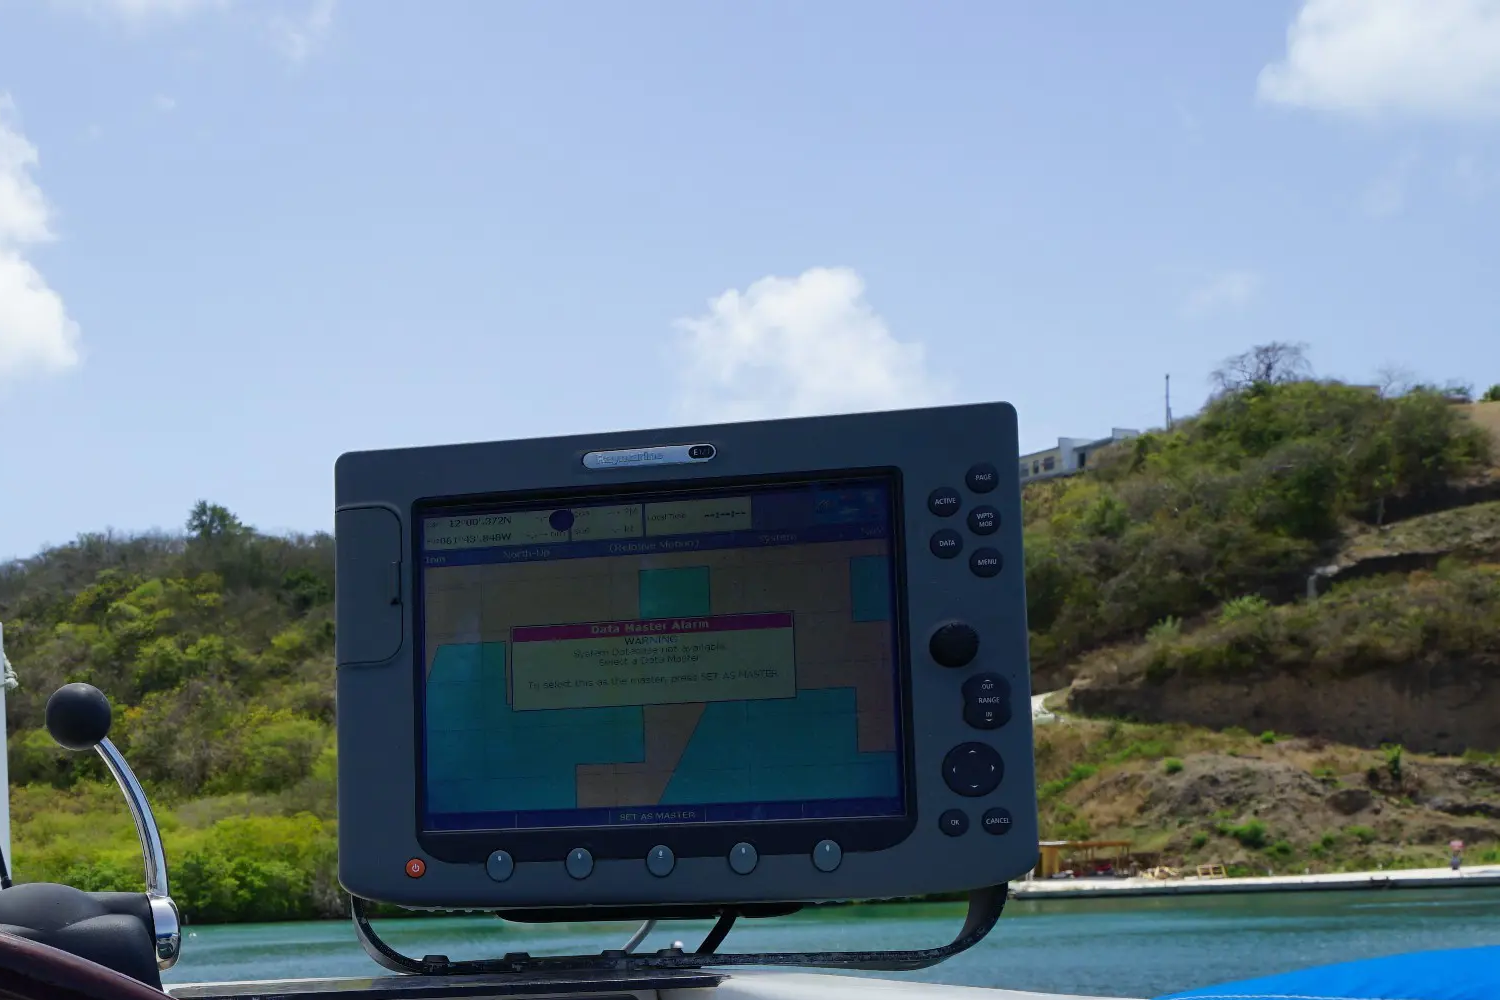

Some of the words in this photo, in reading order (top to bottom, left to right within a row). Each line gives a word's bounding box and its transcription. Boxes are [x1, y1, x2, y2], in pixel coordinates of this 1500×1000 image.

[935, 497, 957, 505] ACTIVE
[976, 512, 994, 520] WPTS
[503, 549, 550, 561] North-Up
[591, 624, 620, 634] Data
[625, 622, 667, 632] Master
[671, 619, 709, 630] Alarm
[624, 635, 678, 645] WARNING
[573, 648, 609, 659] System
[661, 644, 678, 653] not
[598, 657, 629, 667] Select
[641, 655, 664, 665] Data
[668, 653, 699, 663] Master
[544, 678, 572, 689] select
[575, 677, 594, 687] this
[598, 677, 609, 686] as
[611, 675, 627, 686] the
[671, 673, 698, 683] press
[701, 671, 718, 681] SET
[723, 670, 736, 680] AS
[739, 668, 778, 679] MASTER
[978, 696, 1000, 704] RANGE
[620, 813, 636, 821] SET
[641, 812, 653, 820] AS
[656, 811, 696, 820] MASTER
[985, 816, 1011, 825] CANCEL
